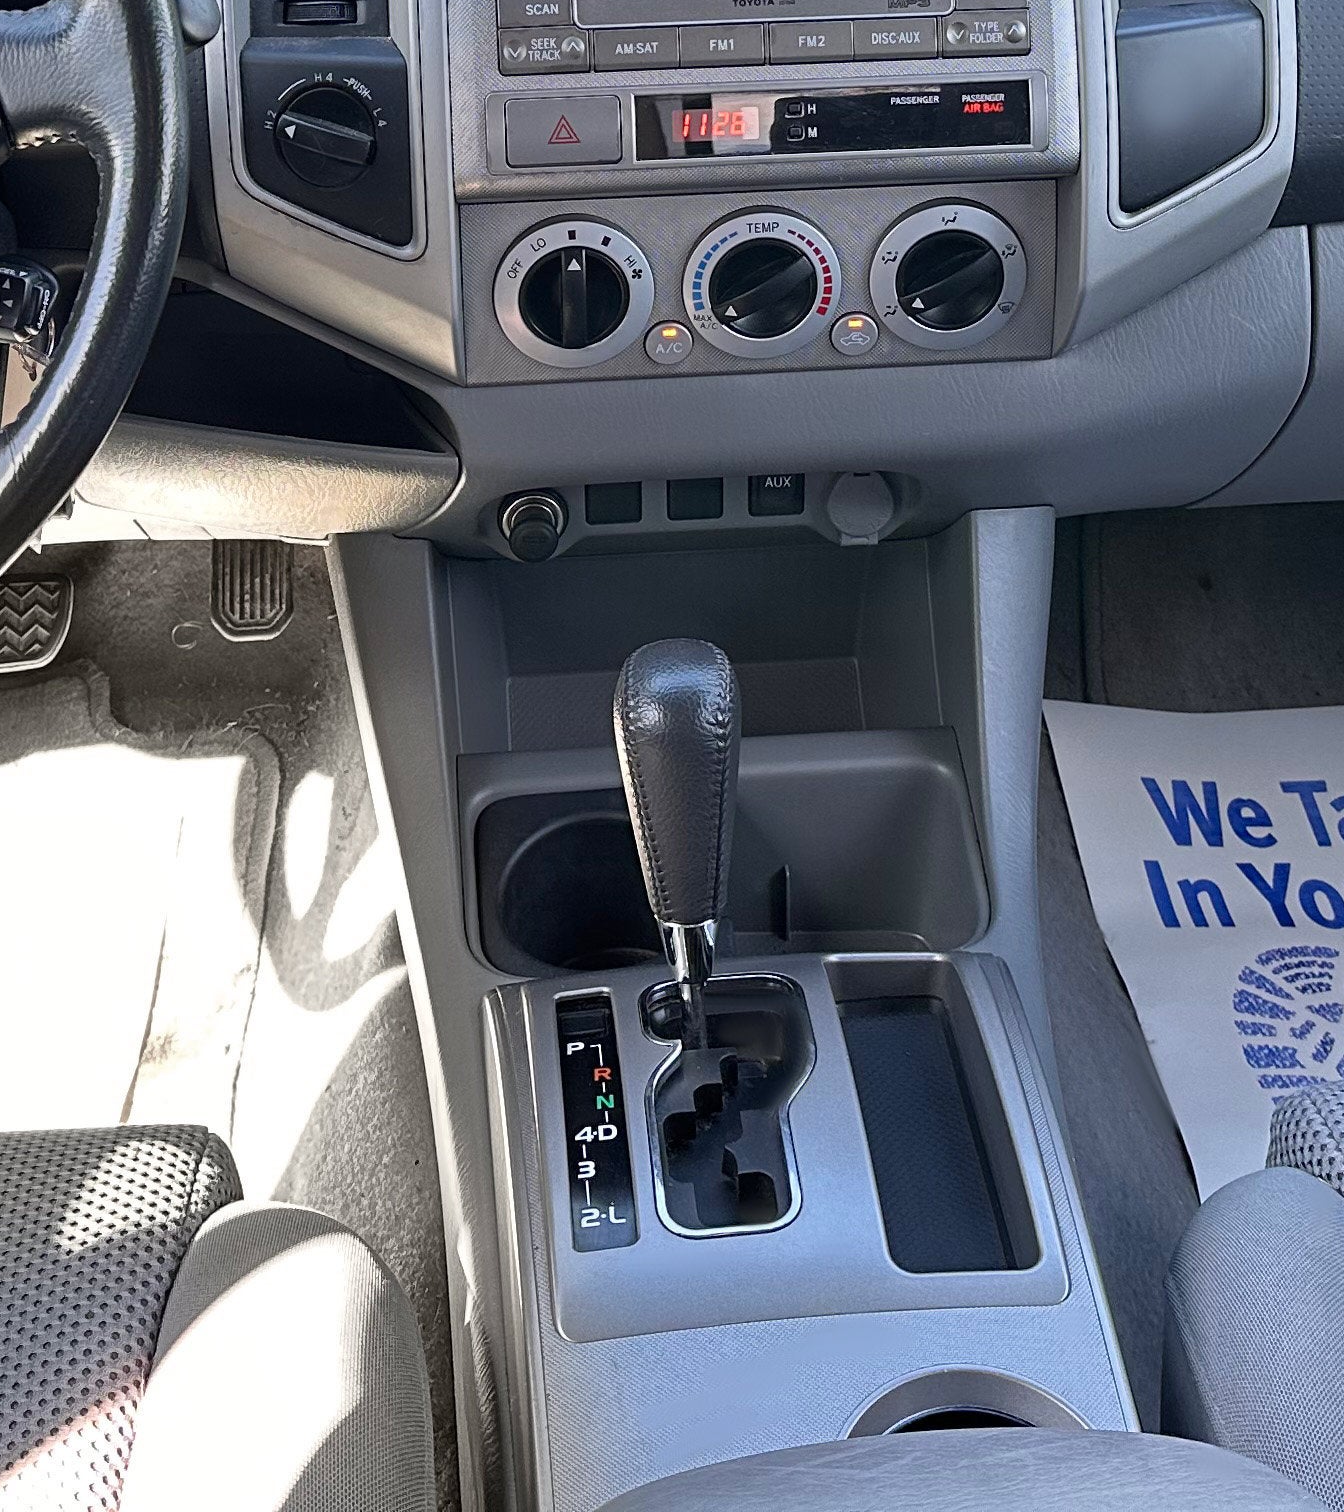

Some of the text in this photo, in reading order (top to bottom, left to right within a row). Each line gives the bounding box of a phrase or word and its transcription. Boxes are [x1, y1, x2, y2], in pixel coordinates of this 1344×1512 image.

[525, 4, 560, 16] SCAN
[974, 21, 1000, 32] TYPE
[531, 38, 557, 50] SEEK
[798, 35, 826, 48] FM2
[969, 32, 1004, 44] FOLDER
[709, 39, 735, 51] FM1
[528, 49, 562, 62] TRACK
[890, 95, 940, 106] PASSENGER
[962, 93, 1005, 103] PASSENGER
[808, 104, 817, 115] H
[964, 102, 1004, 114] AIR BAG
[808, 127, 818, 138] M
[746, 222, 781, 234] TEMP
[530, 238, 547, 252] LO
[623, 254, 636, 269] HI
[507, 258, 523, 280] OFF
[693, 314, 713, 322] MAX
[656, 343, 683, 355] A/C
[764, 475, 791, 488] AUX
[1140, 777, 1275, 848] We
[1142, 859, 1235, 929] In
[566, 1041, 585, 1055] P
[593, 1067, 612, 1081] R
[596, 1094, 614, 1109] N
[577, 1160, 596, 1179] 3
